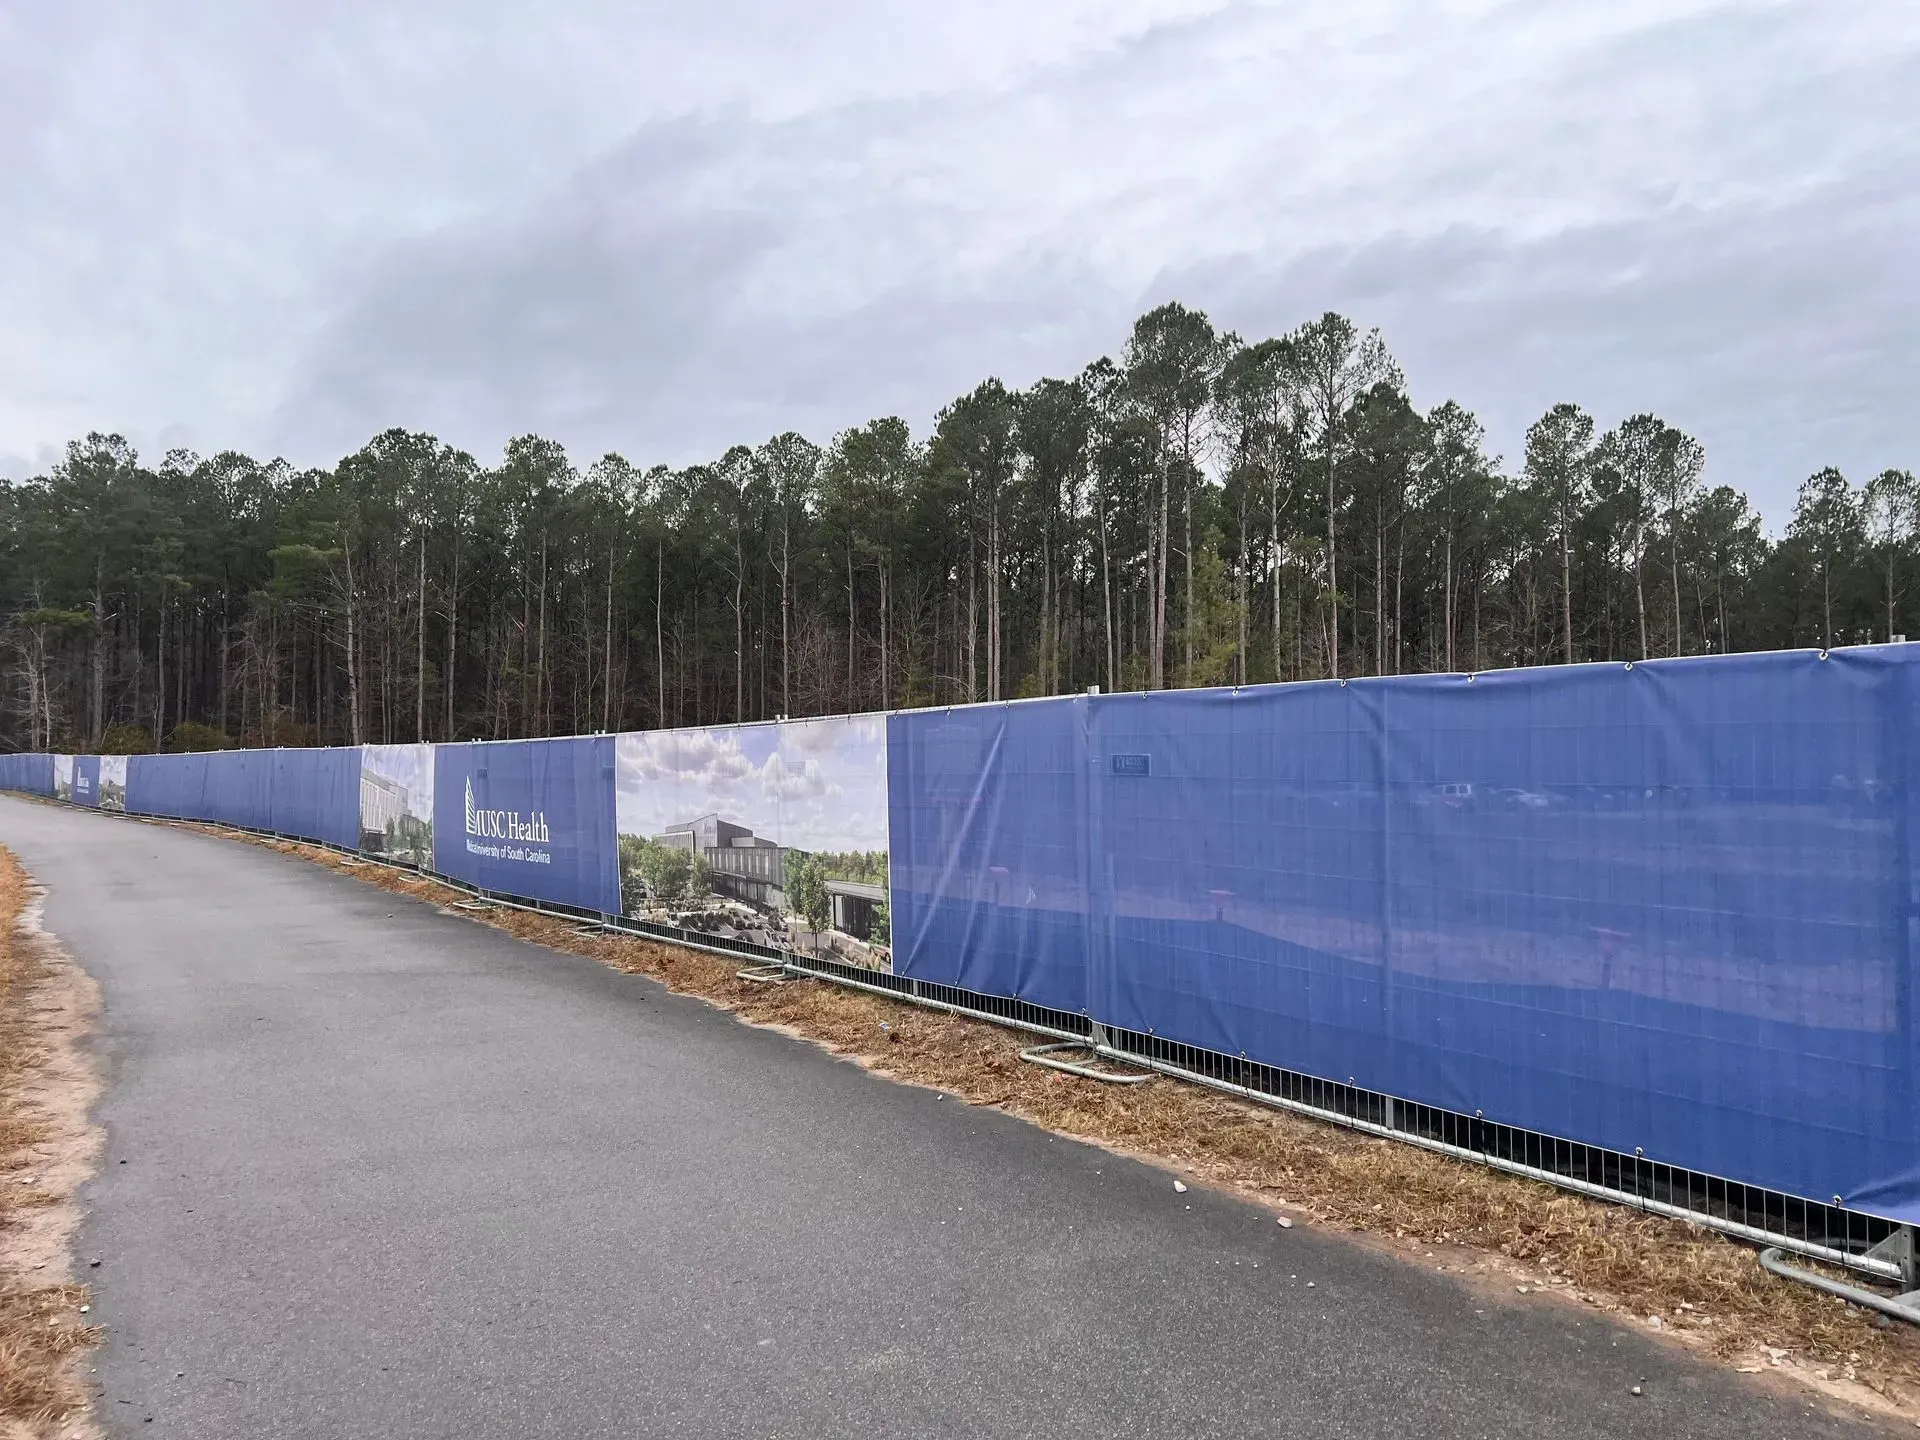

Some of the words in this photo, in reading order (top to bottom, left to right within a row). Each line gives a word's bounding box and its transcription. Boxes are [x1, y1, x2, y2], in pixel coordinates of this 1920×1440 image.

[508, 811, 549, 842] Health
[477, 842, 500, 860] niversity
[501, 845, 506, 858] of
[507, 846, 524, 861] South
[525, 847, 550, 864] Carolina
